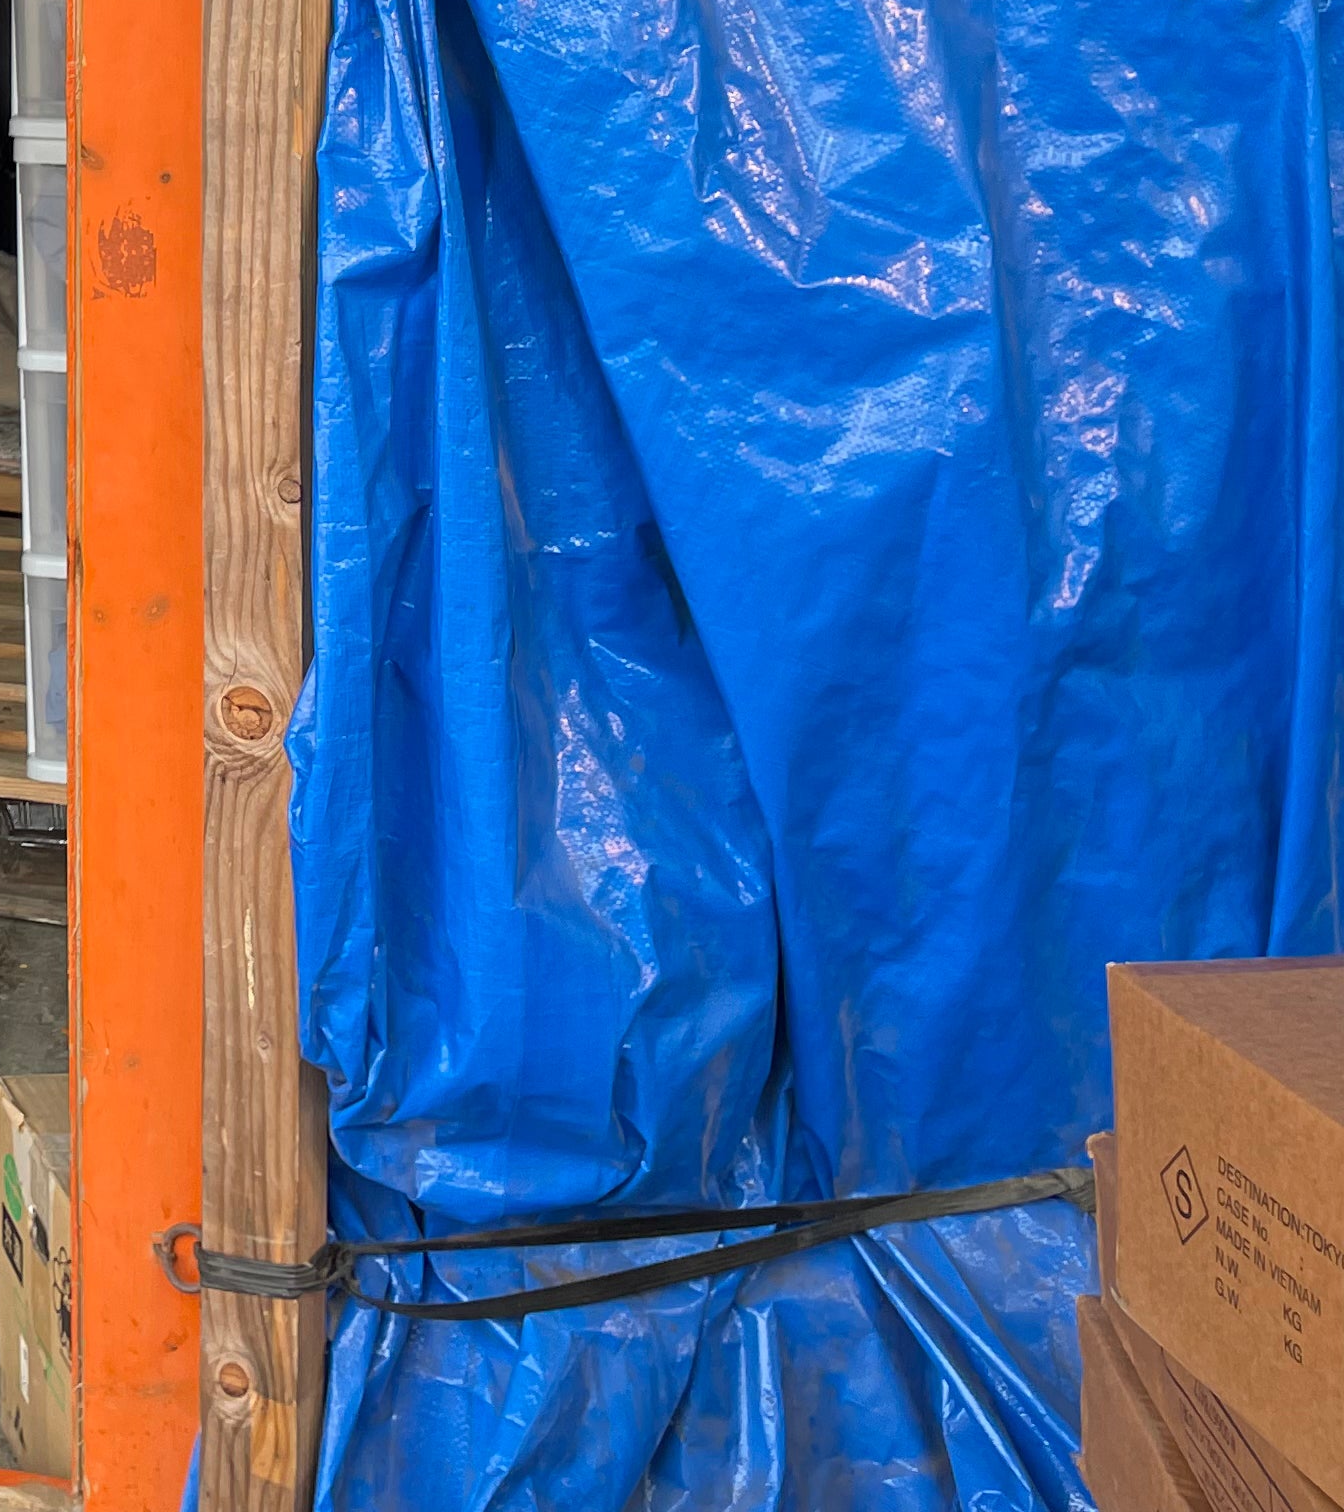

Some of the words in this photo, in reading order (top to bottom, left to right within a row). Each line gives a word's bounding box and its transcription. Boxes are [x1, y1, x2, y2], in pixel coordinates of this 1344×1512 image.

[1175, 1169, 1192, 1219] S
[1217, 1187, 1250, 1227] CASE
[1252, 1215, 1271, 1245] No.
[1218, 1155, 1344, 1271] DESTINATION:TOKY
[1215, 1245, 1242, 1284] N.W.
[1282, 1302, 1303, 1334] KG
[1216, 1215, 1251, 1260] MADE
[1253, 1246, 1266, 1272] IN
[1269, 1260, 1322, 1317] VIETNAM
[1215, 1276, 1242, 1314] G.W.
[1283, 1334, 1303, 1365] KG
